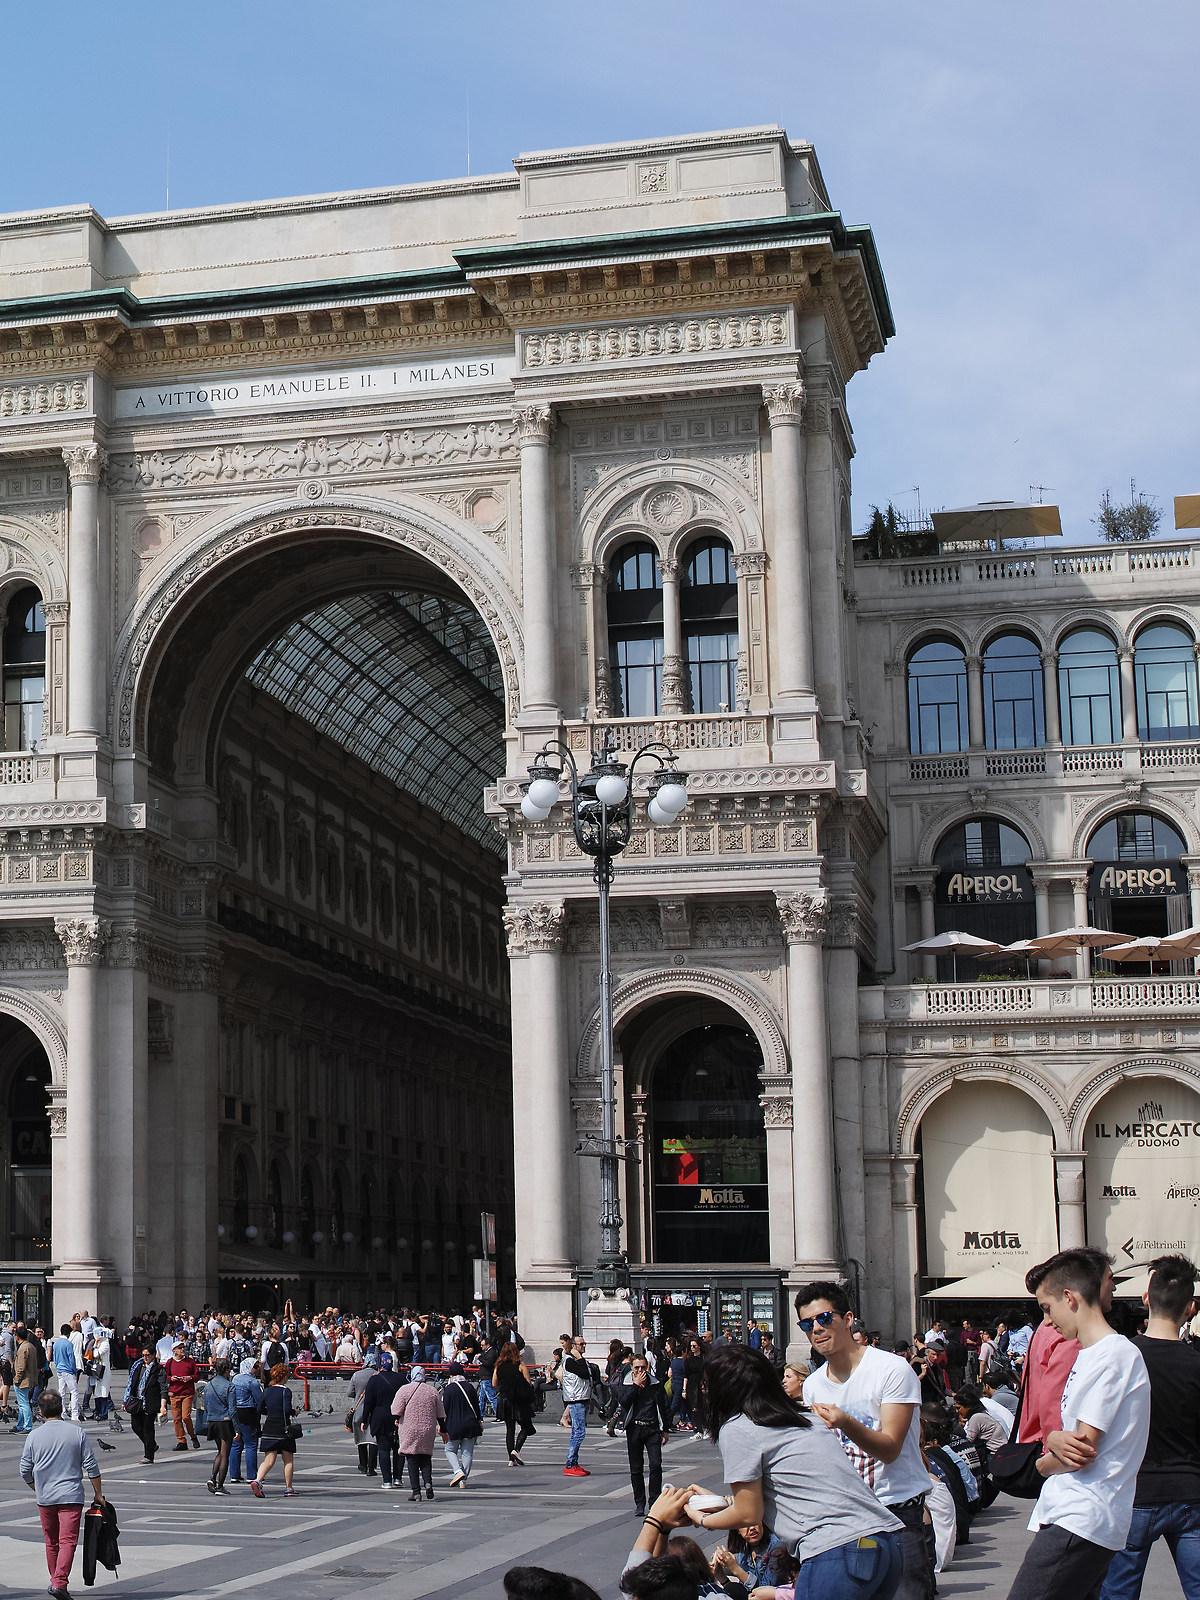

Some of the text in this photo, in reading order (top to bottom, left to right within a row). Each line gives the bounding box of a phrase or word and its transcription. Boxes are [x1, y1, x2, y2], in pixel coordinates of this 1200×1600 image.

[135, 362, 496, 409] A VITTORIO EMANUELE II. I MILANESI
[947, 873, 1023, 896] APEROL
[1100, 866, 1177, 890] APEROL
[947, 892, 1023, 903] TERRAZZA
[1100, 886, 1177, 896] TERRAZZA
[1095, 1123, 1111, 1138] IL
[1137, 1138, 1180, 1147] DUOMO
[699, 1188, 746, 1204] Motta
[1103, 1185, 1137, 1197] Motta
[963, 1230, 1022, 1250] Motta
[1136, 1240, 1186, 1249] laFeltrinelli
